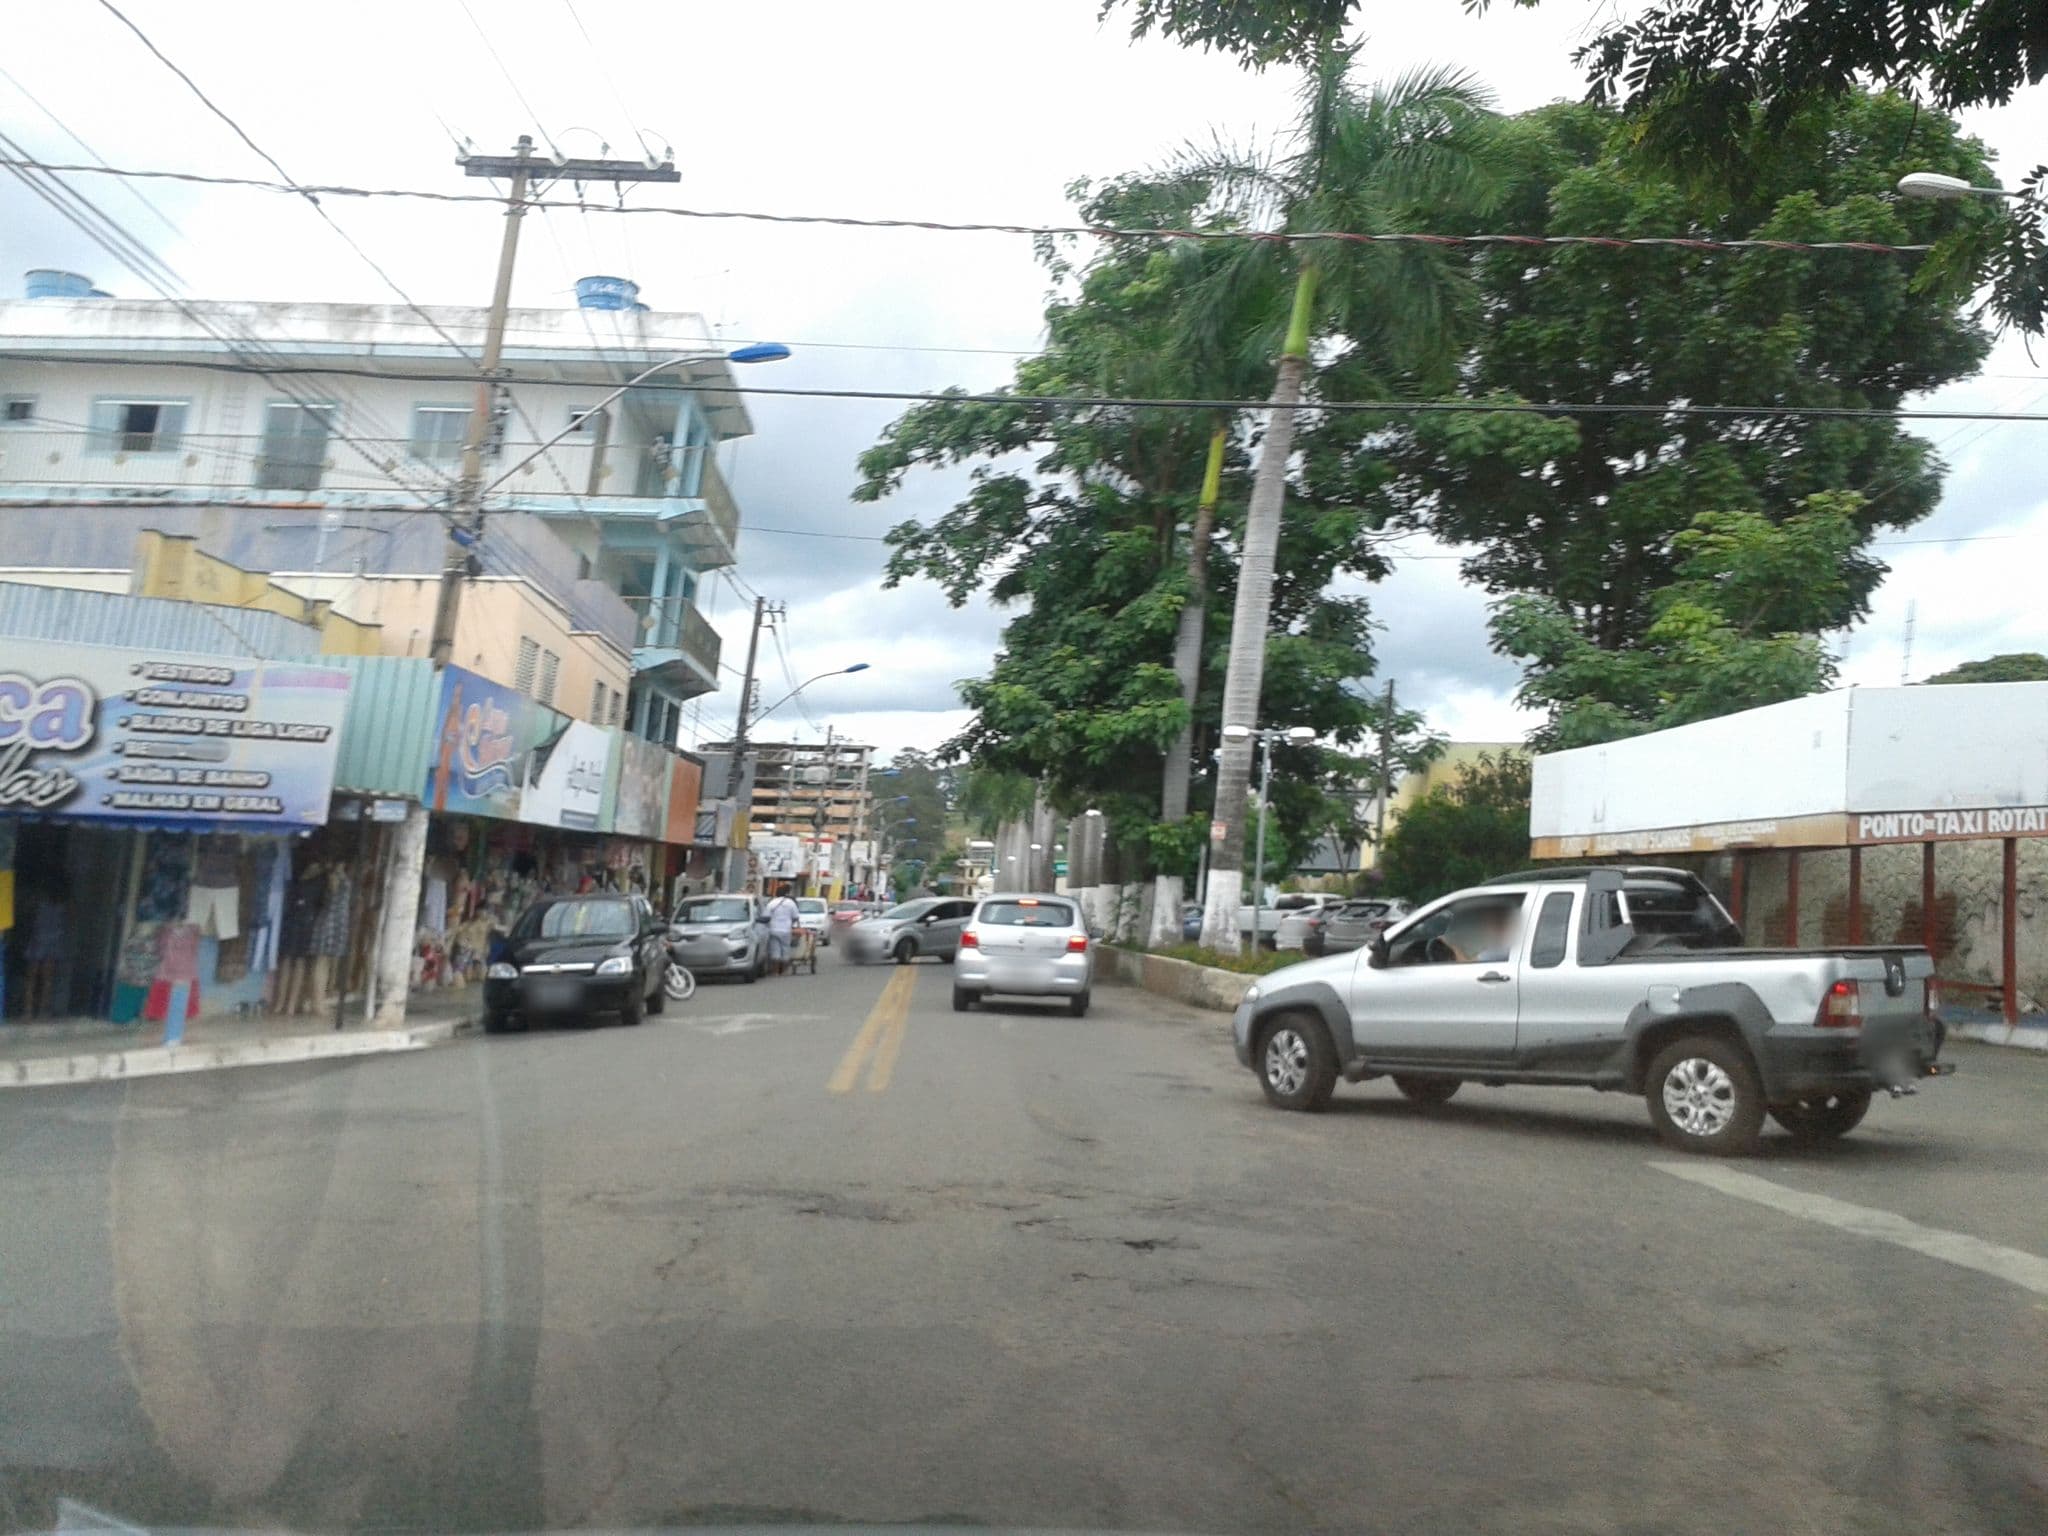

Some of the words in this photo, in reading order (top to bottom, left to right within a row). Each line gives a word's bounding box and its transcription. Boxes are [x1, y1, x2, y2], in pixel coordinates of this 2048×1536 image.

[144, 662, 233, 686] VESTIDOS
[135, 688, 248, 712] CONJUNTOS
[130, 714, 202, 735] BLUSAS
[203, 718, 231, 737] DE
[231, 721, 275, 739] LIGA
[276, 724, 331, 743] LIGHT
[177, 768, 204, 785] DE
[204, 770, 270, 788] BANHO
[112, 792, 190, 808] MALHAS
[192, 795, 221, 811] EM
[222, 796, 283, 813] GERAL
